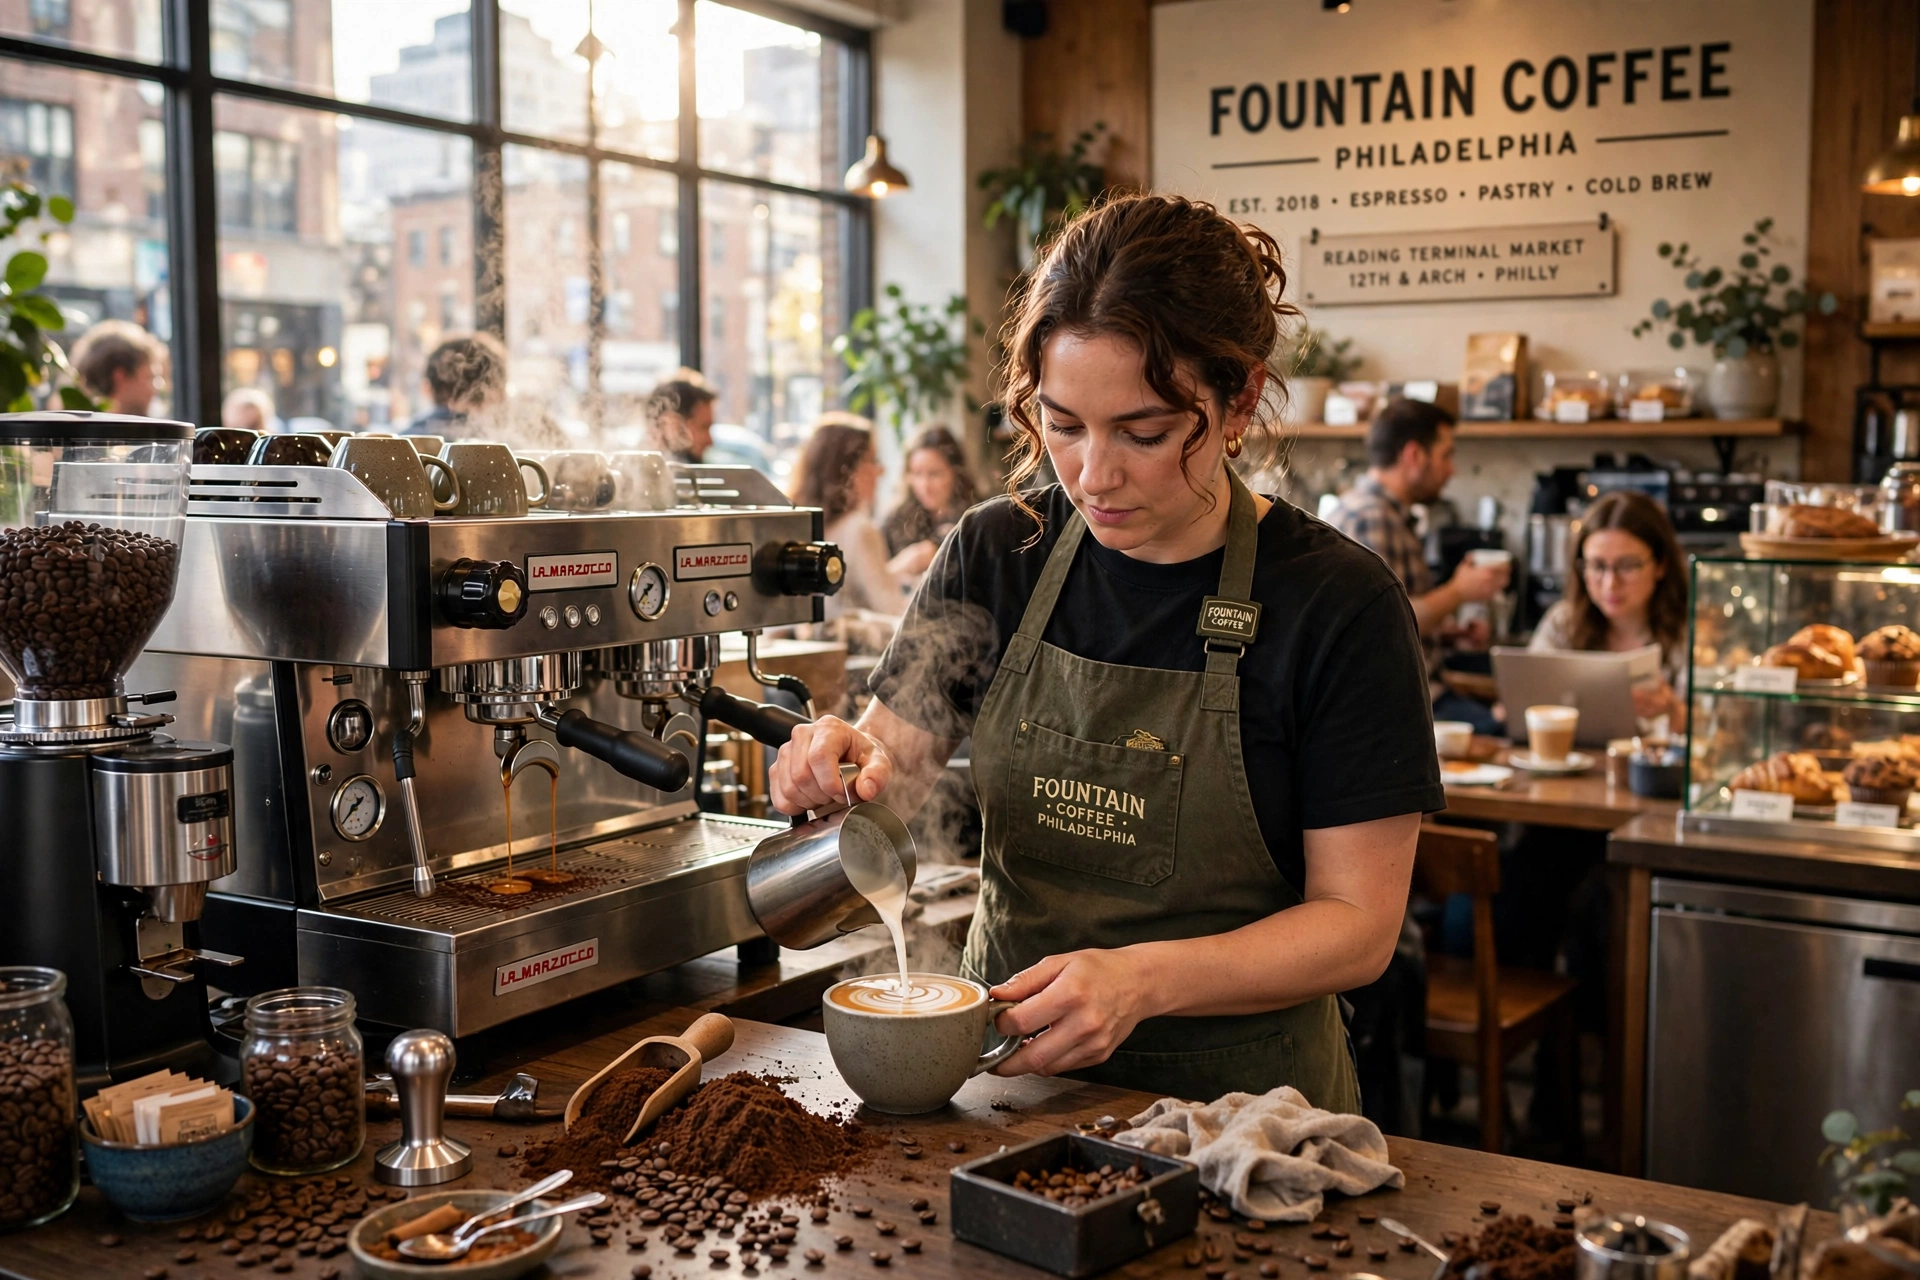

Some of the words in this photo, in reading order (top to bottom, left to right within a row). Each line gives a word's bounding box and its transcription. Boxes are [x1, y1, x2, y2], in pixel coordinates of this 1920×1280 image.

[1210, 65, 1475, 136] FOUNTAIN
[1502, 42, 1731, 113] COFFEE
[1336, 131, 1577, 169] PHILADELPHIA
[1230, 198, 1266, 213] EST.
[1276, 194, 1320, 211] 2018
[1350, 187, 1447, 207] ESPRESSO
[1479, 181, 1554, 200] PASTRY
[1586, 176, 1641, 195] COLD
[1652, 172, 1713, 191] BREW
[1324, 248, 1401, 266] READING
[1410, 244, 1500, 262] TERMINAL
[1510, 239, 1584, 256] MARKET
[1349, 271, 1390, 288] 12TH
[1400, 270, 1410, 286] &
[1418, 268, 1466, 285] ARCH
[1495, 265, 1559, 282] PHILLY
[550, 562, 612, 577] MARZOCCO
[696, 554, 748, 568] MARZOCCO
[1208, 606, 1253, 622] FOUNTAIN
[1033, 776, 1145, 819] FOUNTAIN
[1038, 812, 1136, 846] PHILADELPHIA
[1056, 802, 1115, 826] COFFEE
[521, 946, 594, 979] MARZOCCO
